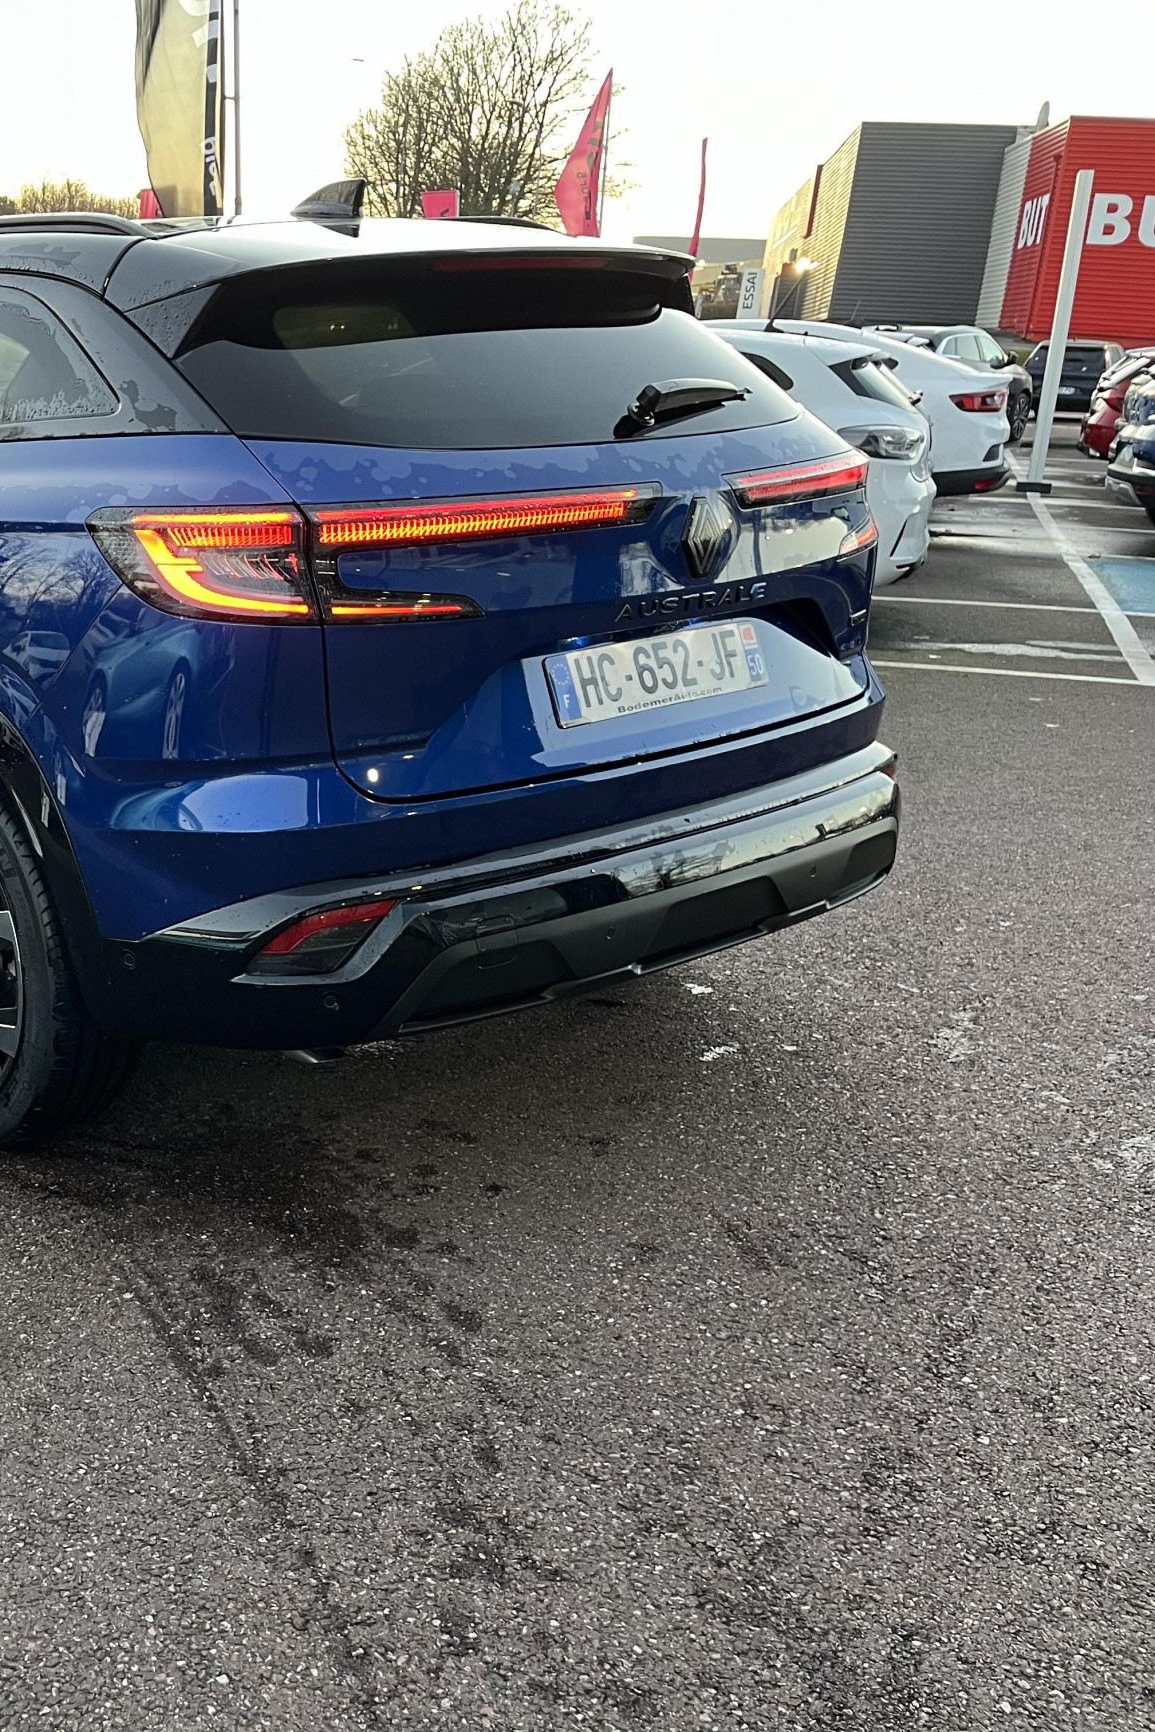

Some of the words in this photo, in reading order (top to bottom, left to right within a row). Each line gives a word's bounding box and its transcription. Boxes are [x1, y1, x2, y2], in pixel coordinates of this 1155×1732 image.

[1017, 193, 1050, 250] BUT
[742, 272, 757, 309] ESSAI
[747, 654, 764, 676] 50
[562, 693, 571, 709] F
[617, 686, 723, 714] BodemerAuto.com
